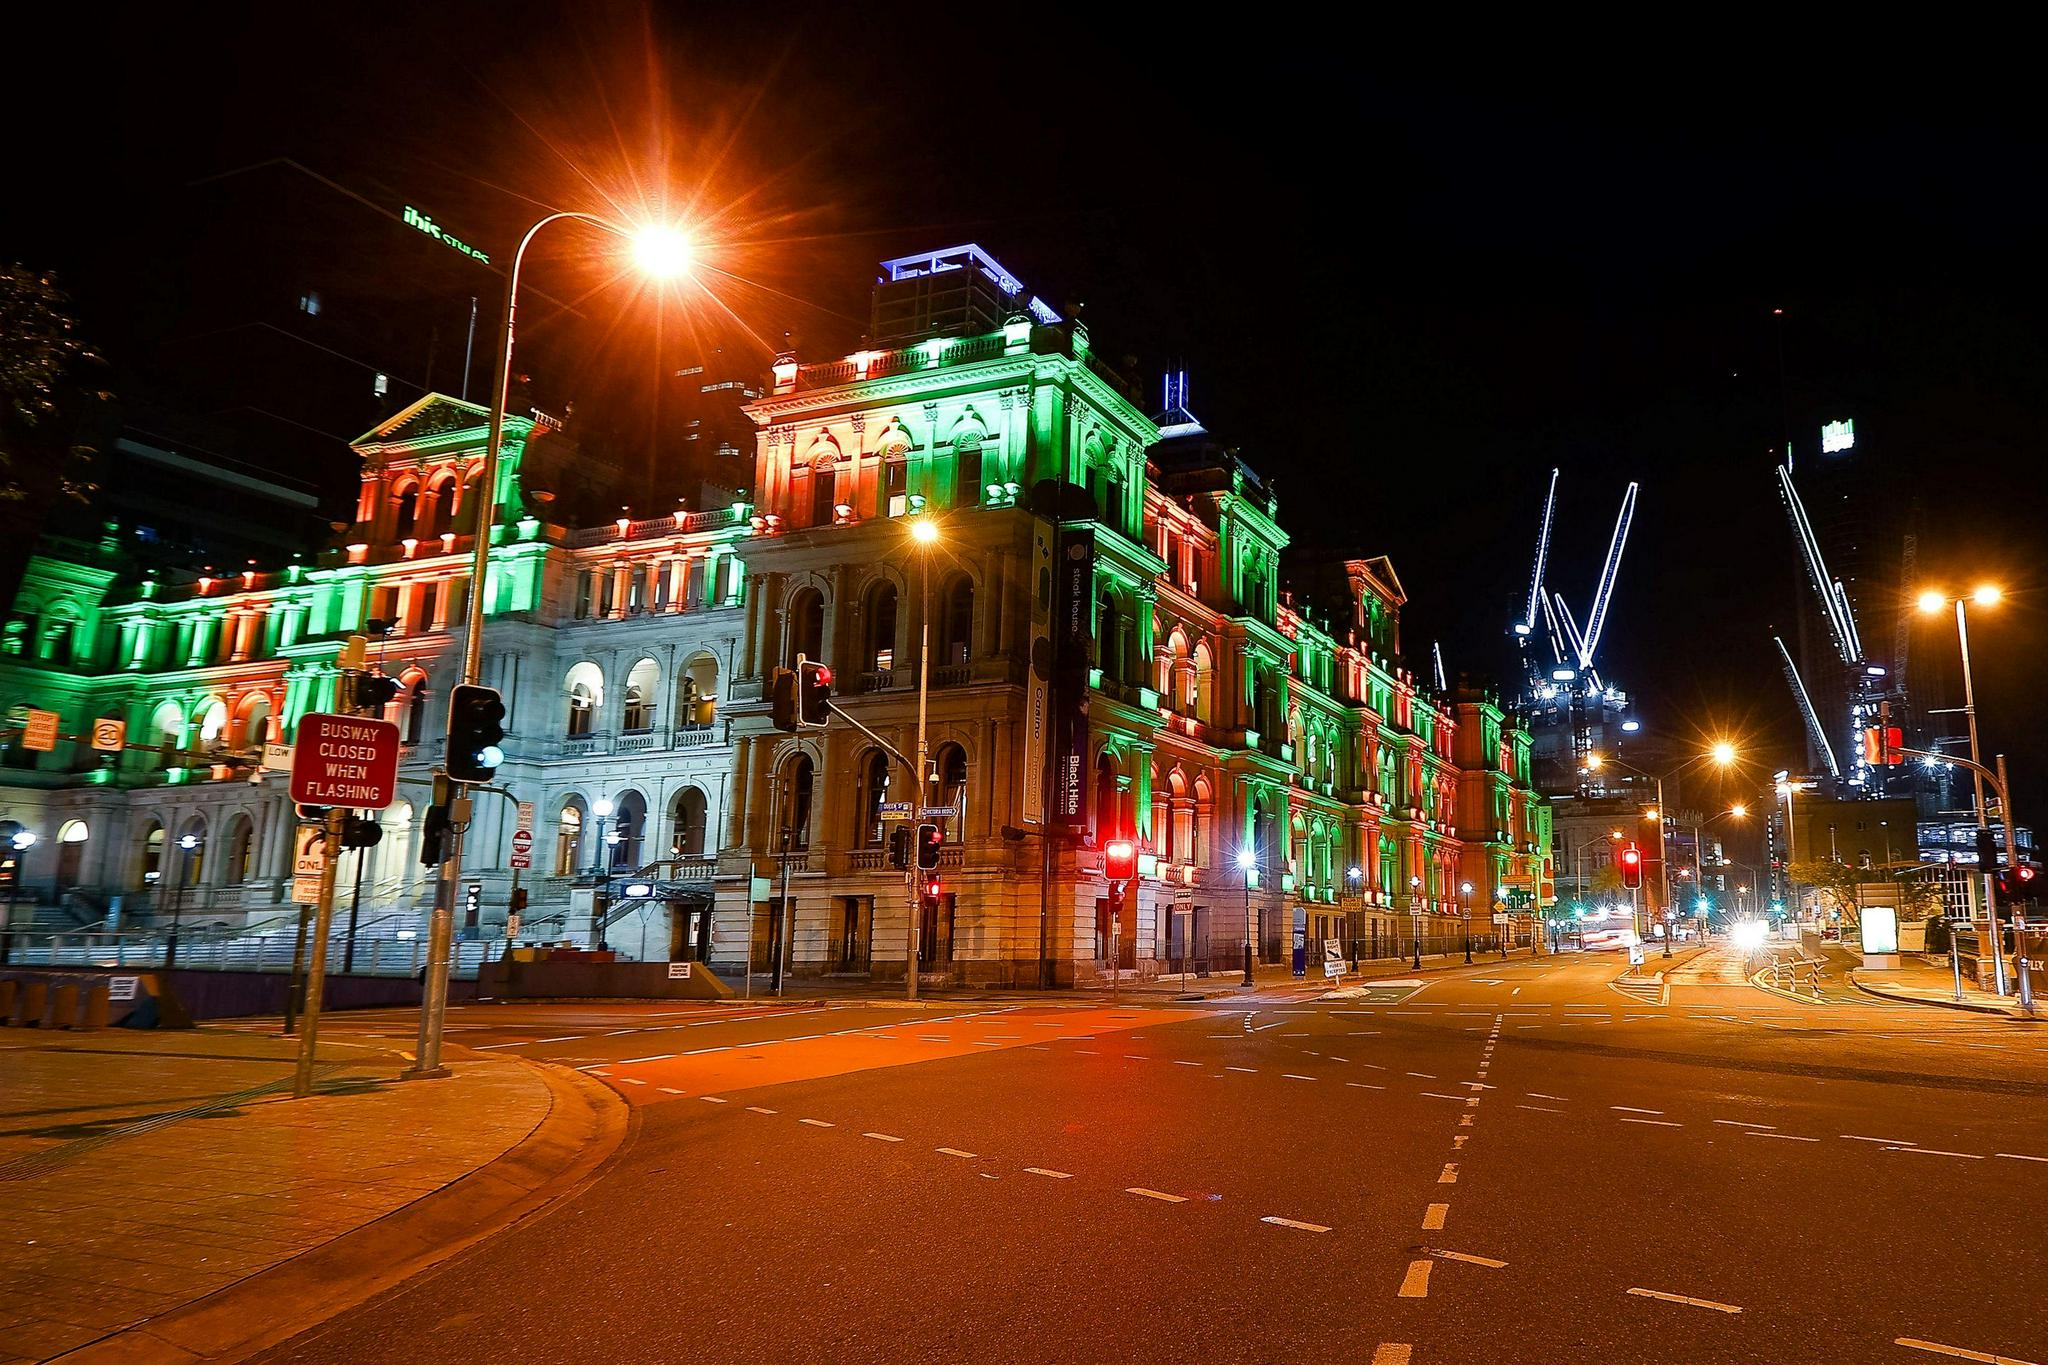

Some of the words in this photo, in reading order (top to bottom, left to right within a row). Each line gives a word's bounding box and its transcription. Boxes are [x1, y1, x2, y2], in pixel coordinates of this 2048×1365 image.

[1072, 567, 1081, 597] steak
[1071, 600, 1080, 632] house
[1033, 687, 1043, 740] Casino
[320, 722, 380, 743] BUSWAY
[268, 747, 289, 757] LOW
[319, 742, 377, 761] CLOSED
[326, 762, 368, 780] WHEN
[1069, 755, 1080, 787] Black
[306, 781, 380, 801] FLASHING
[1069, 789, 1079, 815] Hide
[297, 859, 322, 871] ONL
[1176, 903, 1191, 911] ONLY
